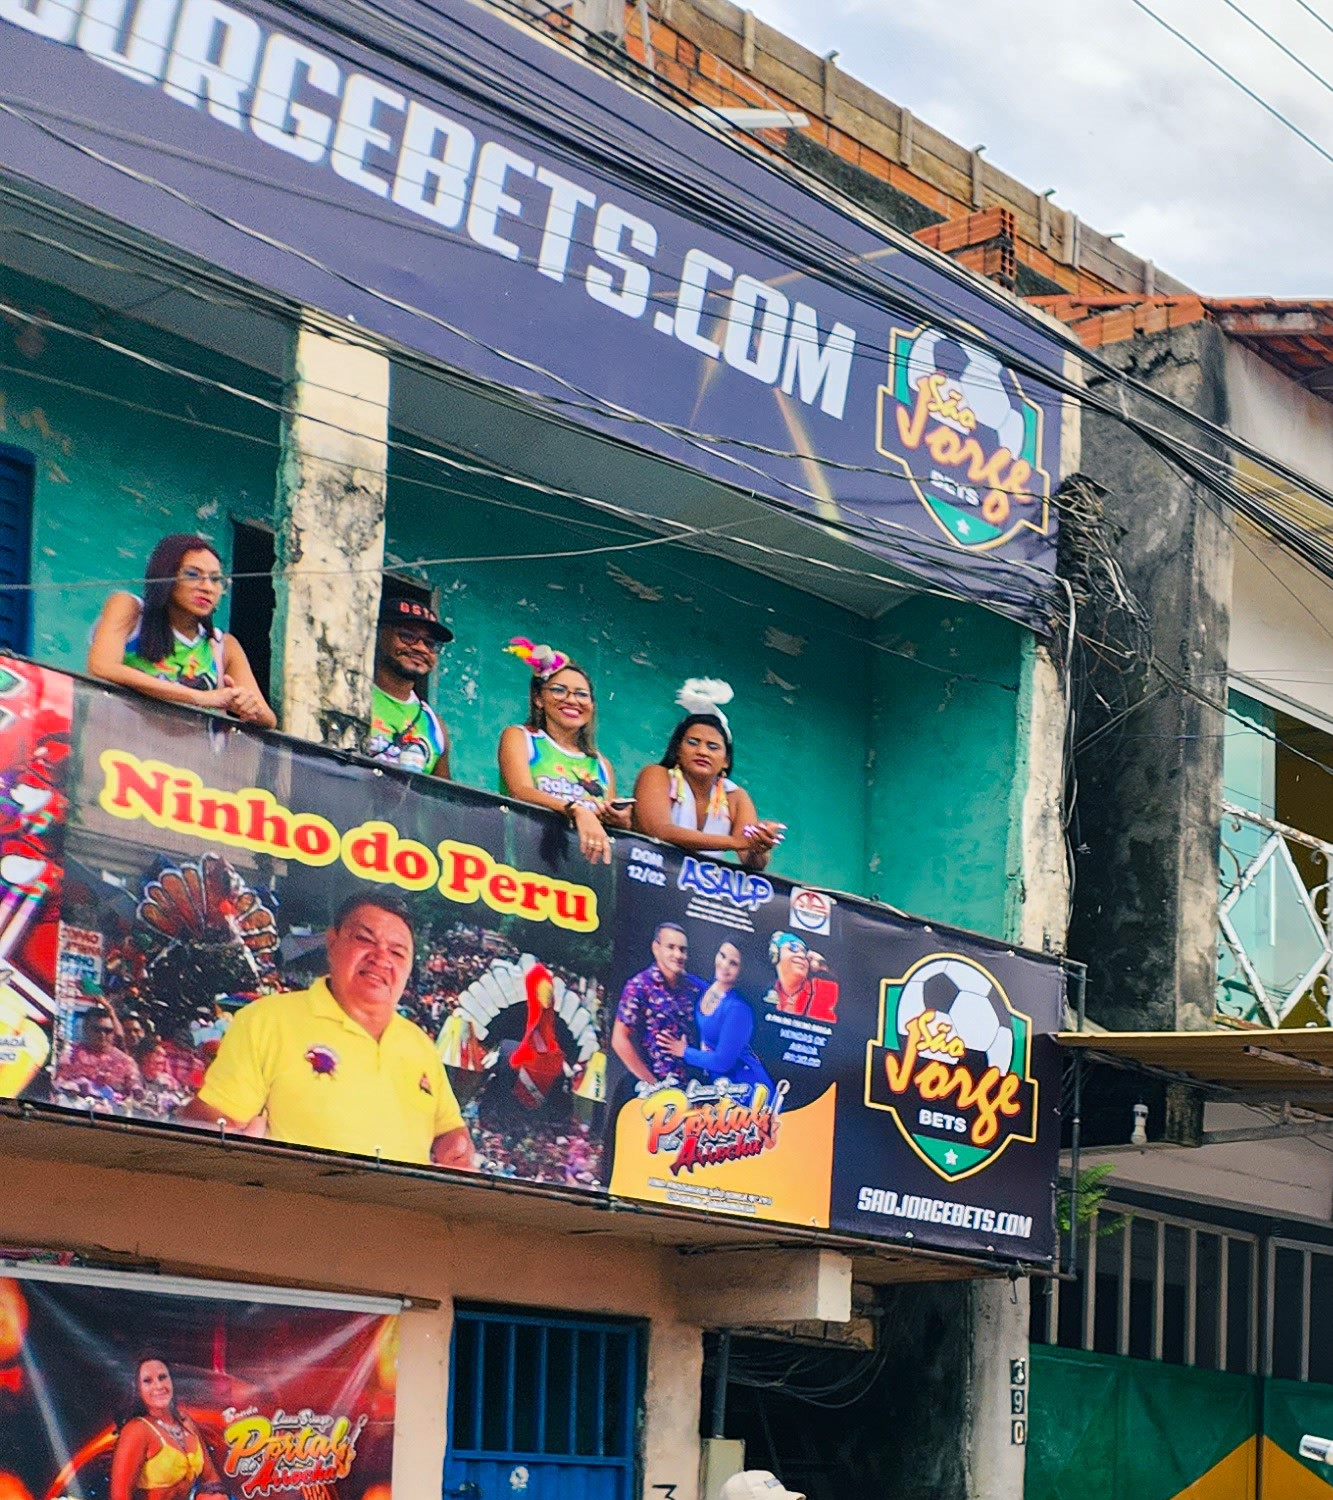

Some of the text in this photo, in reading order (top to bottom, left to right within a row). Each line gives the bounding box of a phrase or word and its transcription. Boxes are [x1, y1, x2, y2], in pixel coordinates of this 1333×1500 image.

[111, 760, 590, 923] Ninho do Peru
[914, 1009, 966, 1059] São
[884, 1018, 1023, 1146] Jorge
[918, 1108, 968, 1135] BETS
[224, 1415, 350, 1479] Portal
